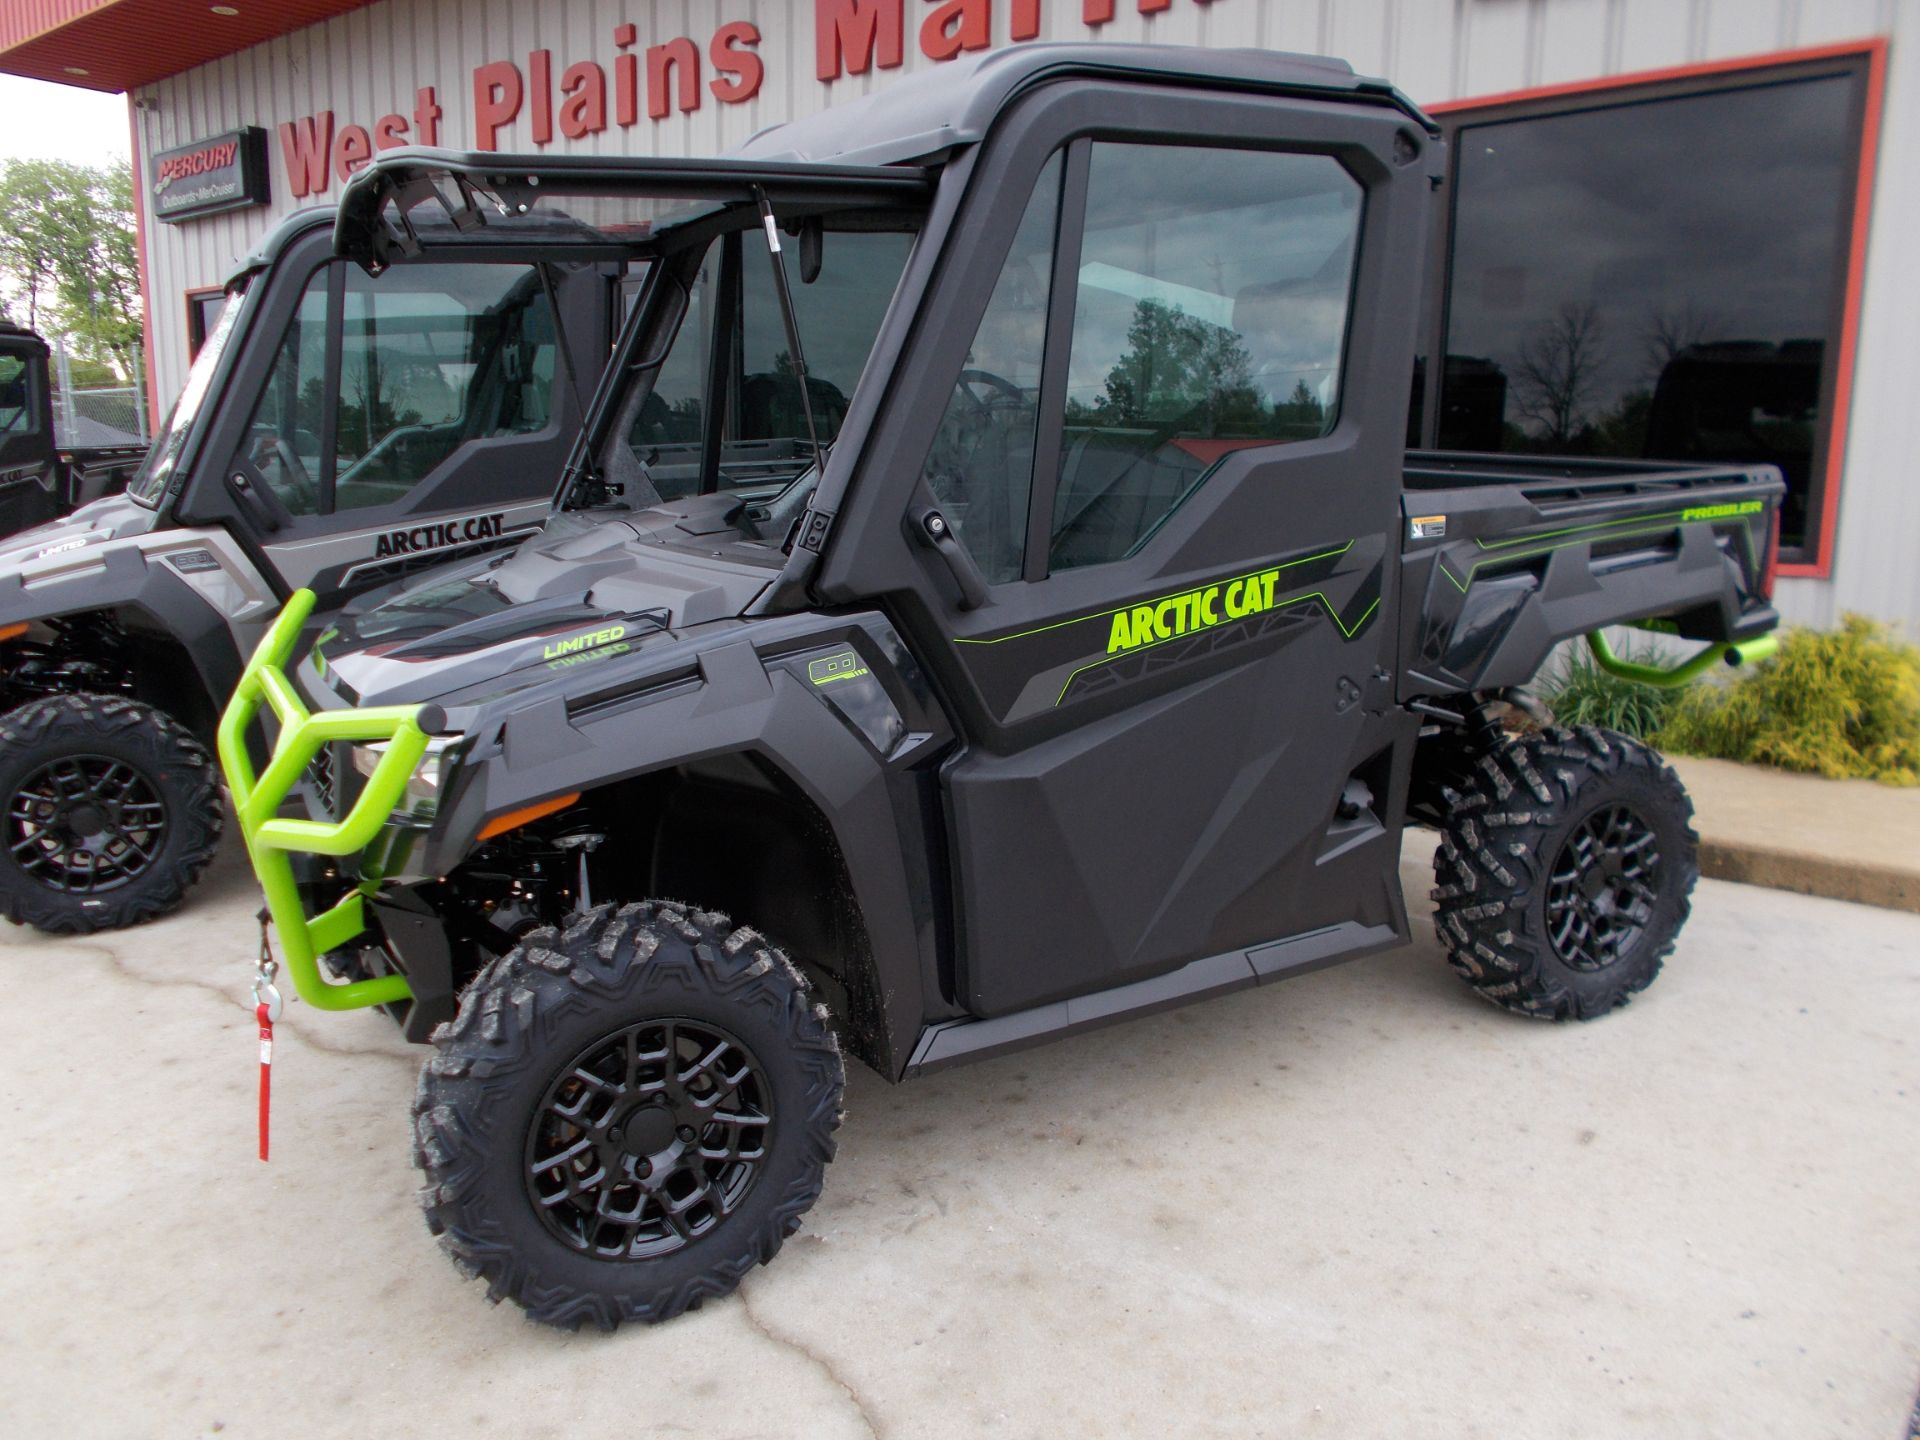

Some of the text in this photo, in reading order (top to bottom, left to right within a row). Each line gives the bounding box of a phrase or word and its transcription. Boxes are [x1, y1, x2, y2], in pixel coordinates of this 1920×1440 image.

[279, 86, 443, 197] West
[473, 20, 764, 151] Plains
[158, 141, 238, 181] MERCURY
[1682, 501, 1762, 520] PROWLER
[39, 539, 87, 558] LIMITED
[375, 513, 504, 558] ARCTIC CAT
[1107, 571, 1279, 654] ARCTIC CAT
[543, 626, 625, 659] LIMITED
